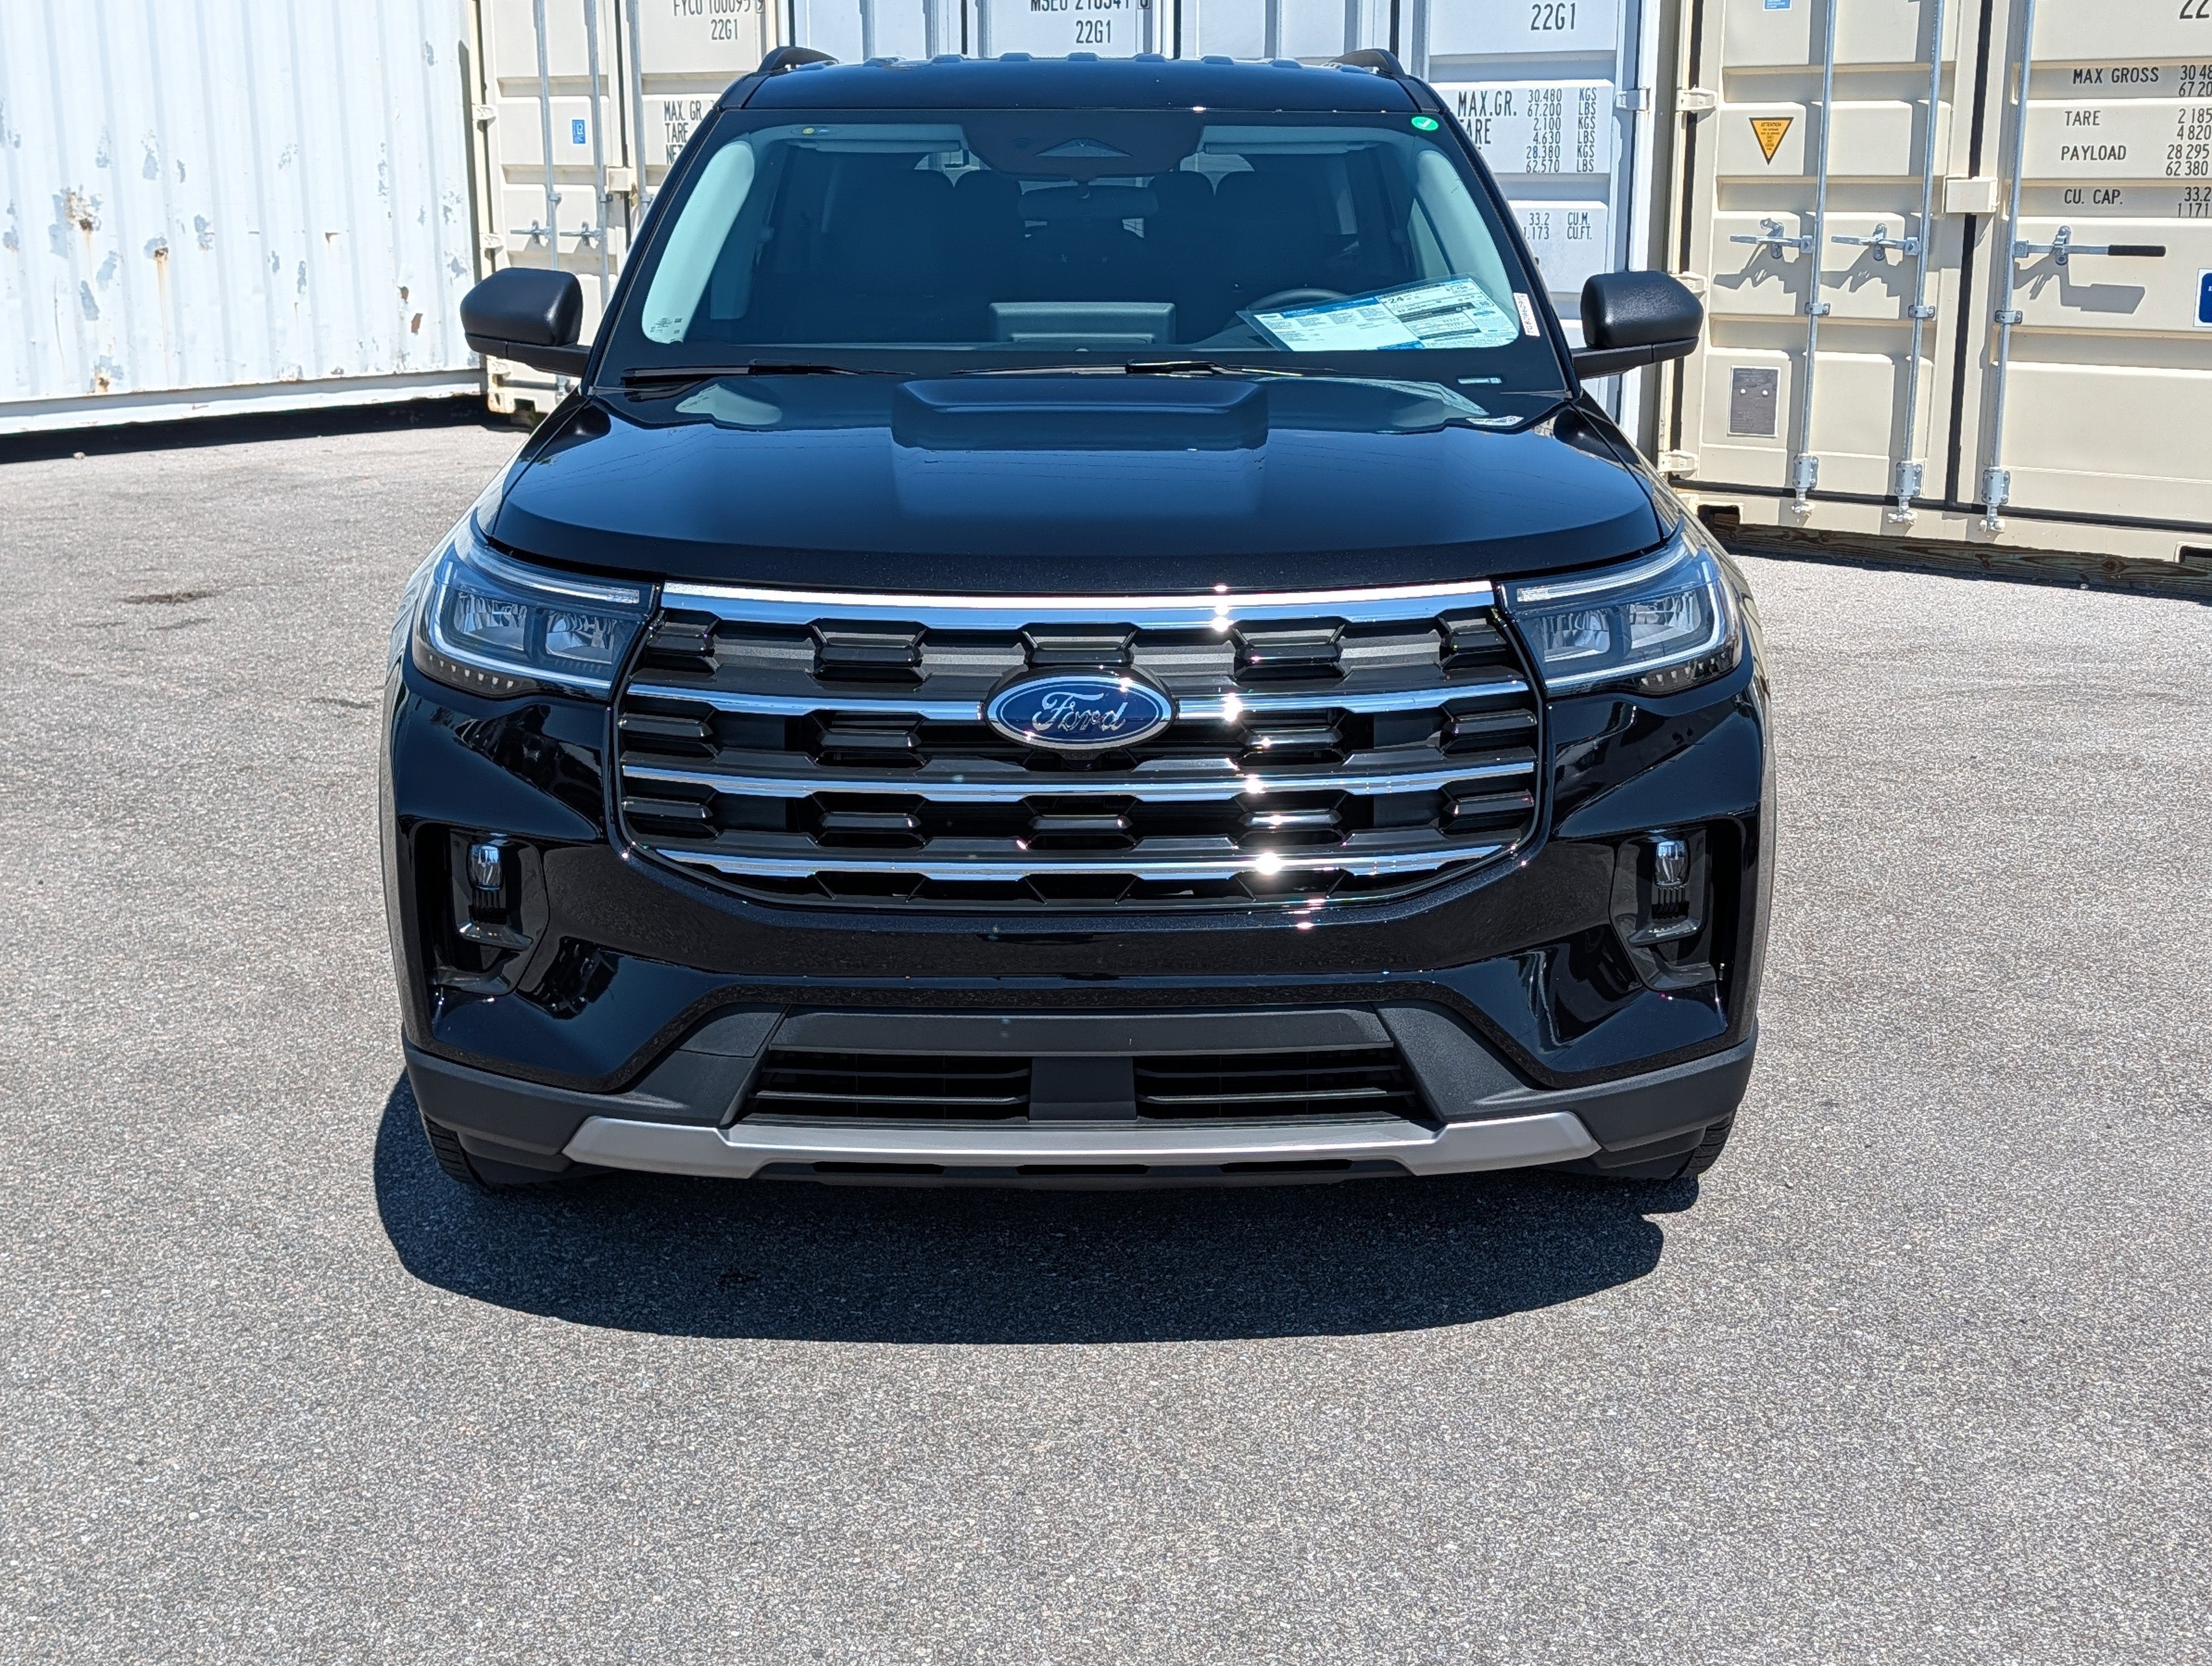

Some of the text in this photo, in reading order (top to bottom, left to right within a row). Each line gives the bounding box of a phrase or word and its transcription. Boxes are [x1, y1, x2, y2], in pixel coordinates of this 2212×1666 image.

[1531, 3, 1576, 31] 22G1
[711, 18, 738, 40] 22G1
[1076, 20, 1111, 43] 22G1
[2073, 68, 2103, 85] MAX
[2112, 67, 2159, 83] GROSS
[1528, 88, 1562, 103] 30,480
[1579, 87, 1597, 101] KGS
[1527, 101, 1596, 117] 67,200 LBS
[2065, 110, 2101, 126] TARE
[665, 123, 688, 143] TARE
[1459, 116, 1596, 145] ARE 2,100 KGS
[1533, 130, 1595, 145] 4,630 LBS
[1526, 144, 1594, 159] 28,380 KGS
[2061, 145, 2126, 161] PAYLOAD
[1526, 159, 1594, 173] 62,570 LBS
[2065, 187, 2211, 204] CU. CAP. 33.2
[1529, 212, 1550, 226] 33.2
[1031, 691, 1128, 732] Ford
